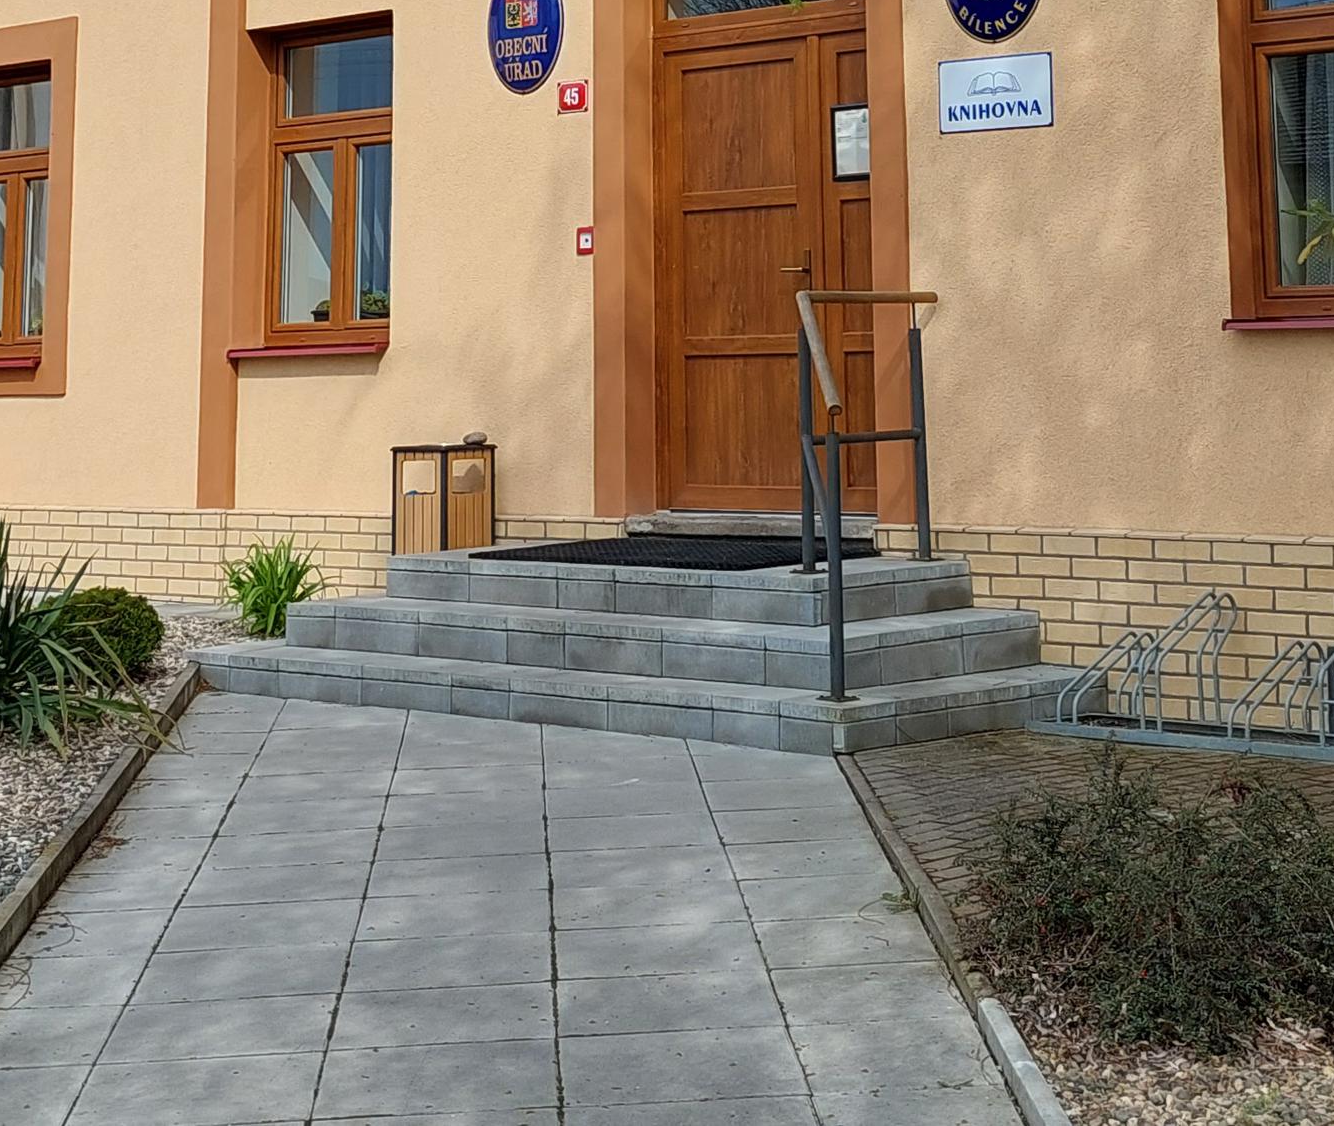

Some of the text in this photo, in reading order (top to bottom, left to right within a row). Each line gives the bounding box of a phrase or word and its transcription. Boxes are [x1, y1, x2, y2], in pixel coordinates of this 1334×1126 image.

[958, 0, 1028, 35] BÍLENCE
[495, 27, 548, 58] OBECNÍ
[504, 57, 543, 82] ÚŘAD
[563, 87, 579, 106] 45
[947, 99, 1042, 122] KNIHOVNA
